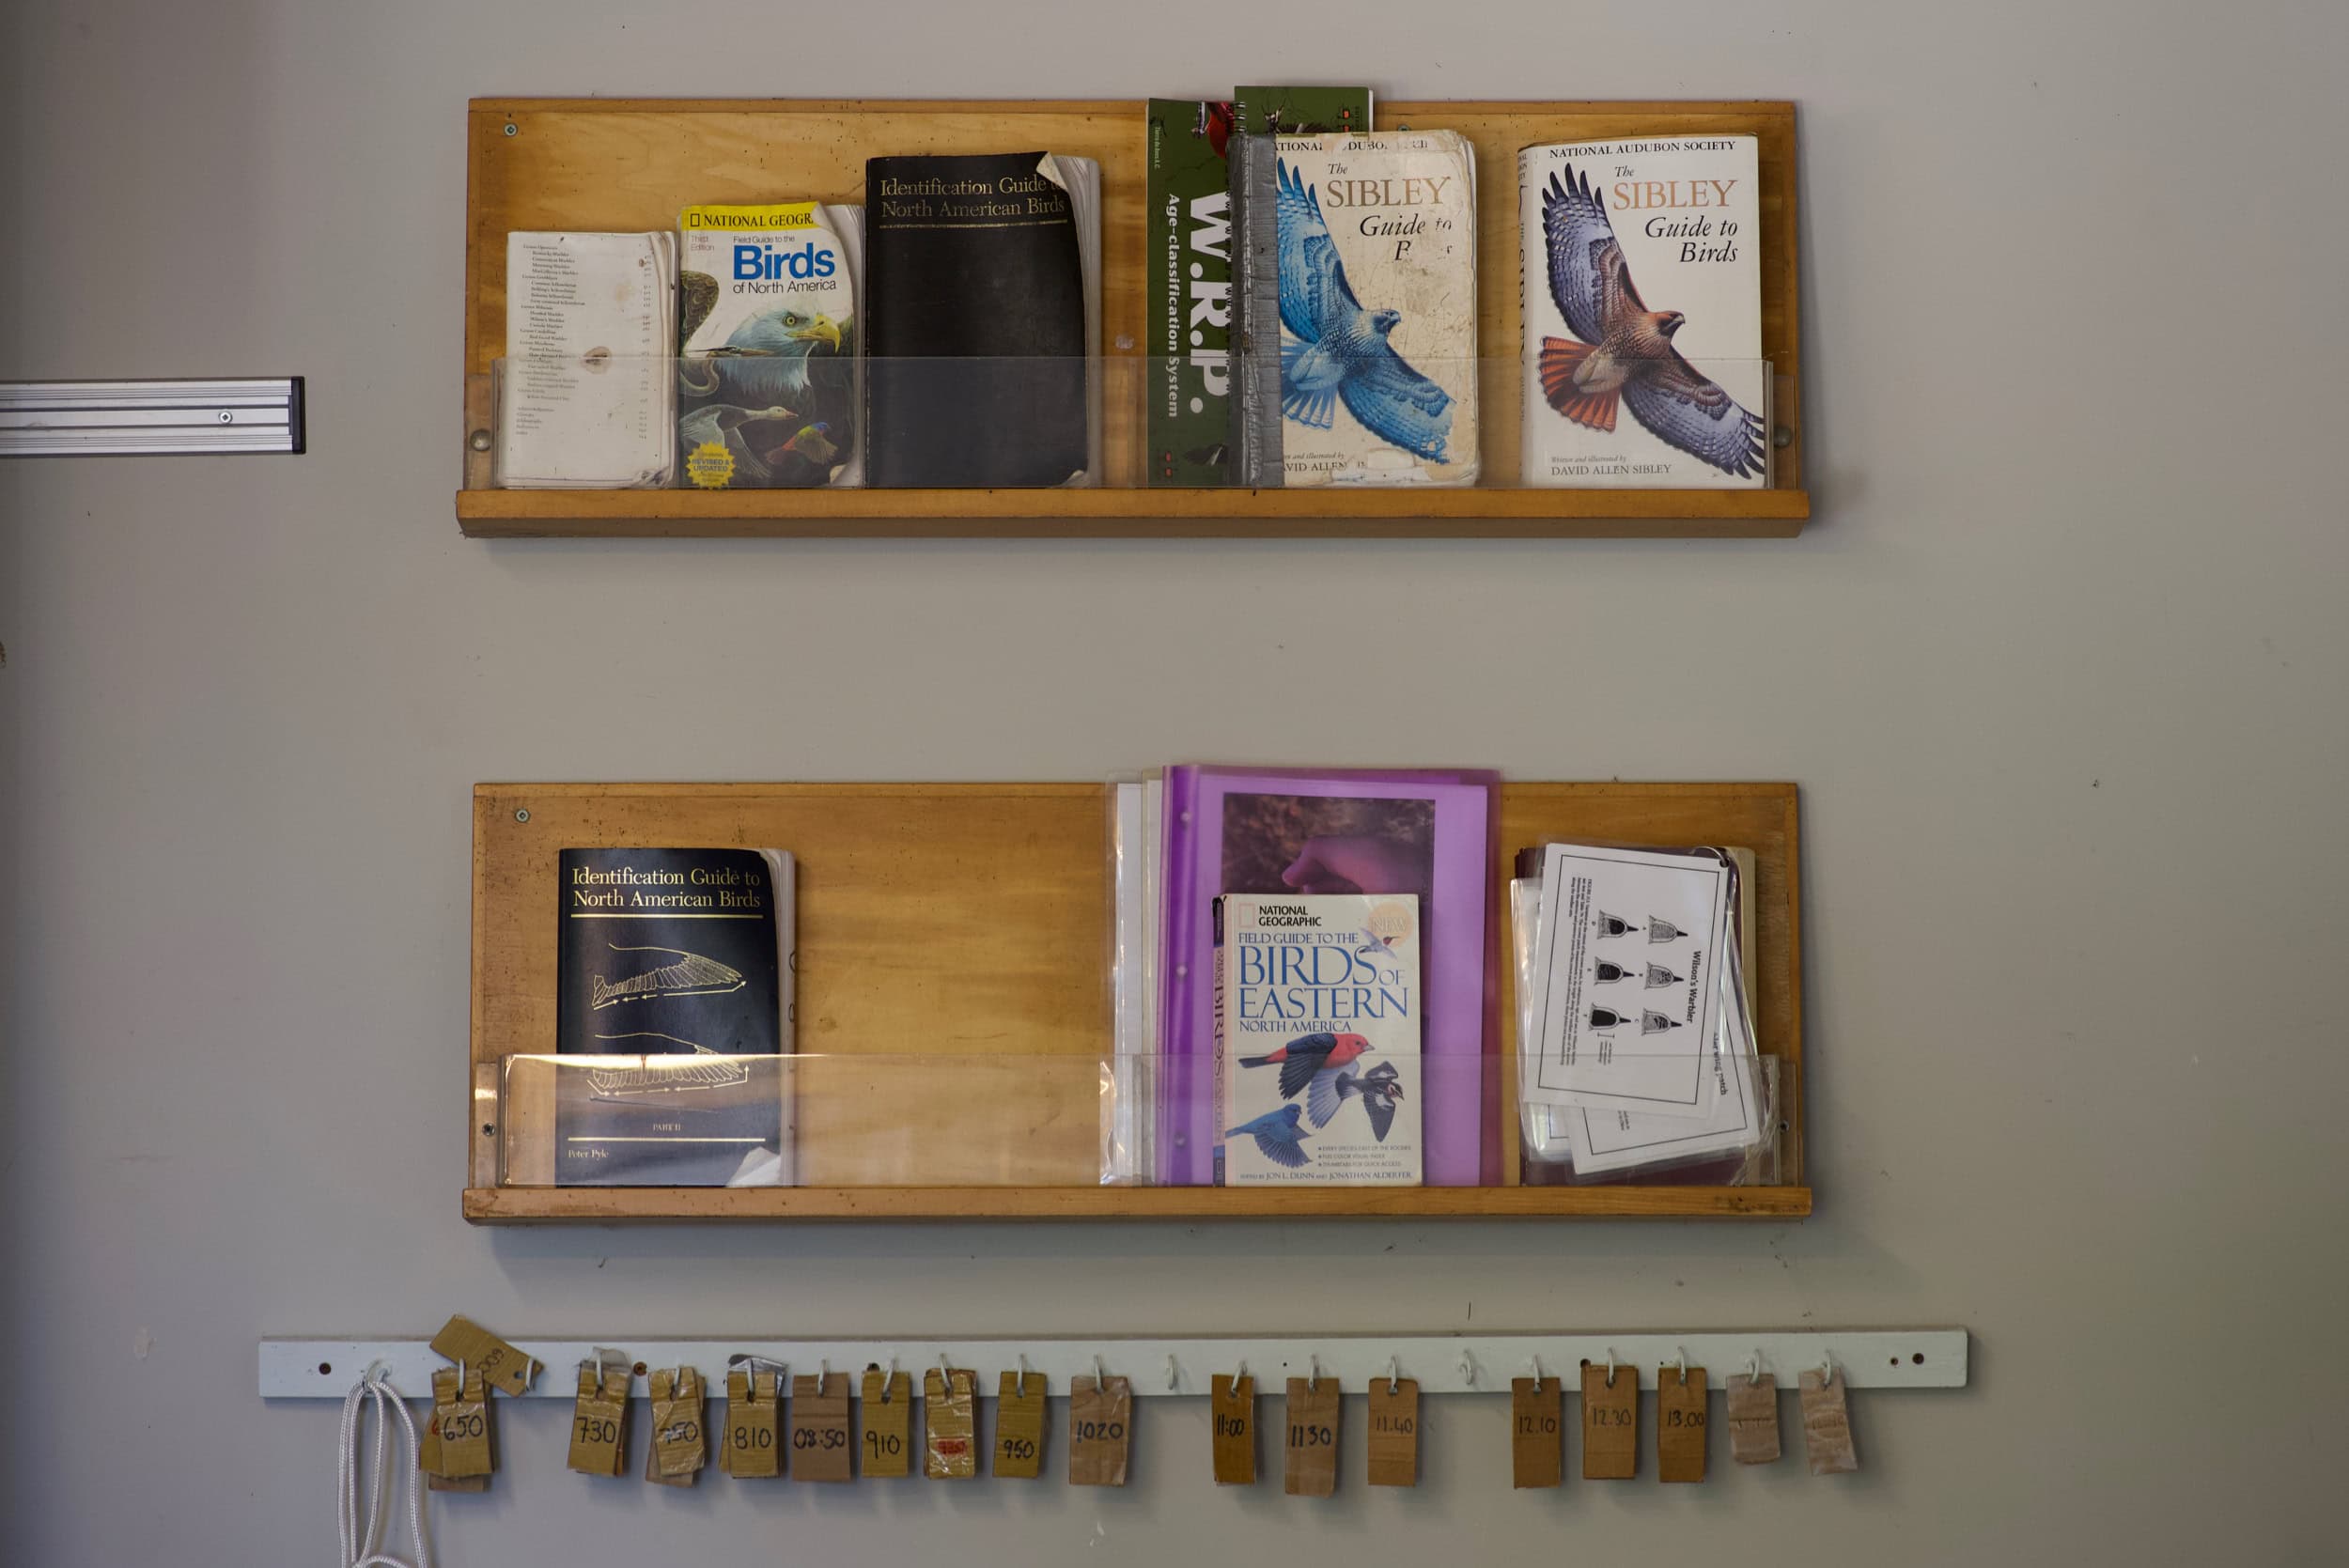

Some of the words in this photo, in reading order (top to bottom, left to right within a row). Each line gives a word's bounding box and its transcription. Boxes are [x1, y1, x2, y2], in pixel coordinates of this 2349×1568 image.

[1549, 146, 1612, 159] NATIONAL
[1616, 142, 1680, 154] AUDUBON
[1684, 141, 1735, 152] SOCIETY
[1328, 163, 1348, 176] The
[1614, 165, 1635, 179] The
[879, 177, 992, 196] Identification
[999, 175, 1047, 194] Guide
[1327, 176, 1452, 208] SIBLEY
[1613, 179, 1738, 210] SIBLEY
[881, 199, 933, 218] North
[941, 201, 1021, 218] American
[1027, 194, 1066, 215] Birds
[704, 214, 766, 227] NATIONAL
[769, 212, 814, 226] GEOGR
[1360, 212, 1426, 237] Guide
[1645, 215, 1712, 238] Guide
[1719, 218, 1738, 236] to
[733, 242, 836, 280] Birds
[1679, 241, 1738, 263] Birds
[733, 284, 745, 294] of
[748, 282, 784, 294] North
[786, 279, 836, 293] America
[1165, 353, 1180, 417] System
[1551, 465, 1590, 475] DAVID
[1593, 465, 1629, 475] ALLEN
[1632, 463, 1672, 474] SIBLEY
[572, 866, 685, 886] Identification
[691, 866, 740, 886] Guide
[744, 872, 760, 886] to
[573, 888, 625, 908] North
[630, 889, 712, 908] American
[719, 889, 761, 908] Birds
[1259, 905, 1309, 916] NATIONAL
[1258, 916, 1322, 927] GEOGRAPHIC
[1238, 932, 1272, 944] FIELD
[1273, 932, 1313, 944] GUIDE
[1316, 932, 1334, 944] TO
[1336, 932, 1360, 944] THE
[1238, 945, 1377, 986] BIRDS
[1378, 969, 1406, 986] OF
[1239, 986, 1409, 1019] EASTERN
[1239, 1020, 1286, 1033] NORTH
[1290, 1020, 1352, 1033] AMERICA
[568, 1149, 589, 1158] Peter
[1216, 1414, 1245, 1437] 11:00
[1376, 1416, 1413, 1436] 11.40
[1518, 1416, 1556, 1436] 12.10
[1592, 1407, 1631, 1427] 12.30
[1667, 1410, 1705, 1429] 13.00
[443, 1414, 484, 1442] 650
[576, 1416, 616, 1444] 730
[735, 1426, 772, 1450] 810
[1077, 1420, 1124, 1444] 1020
[793, 1427, 846, 1451] 08:50
[866, 1430, 901, 1460] 910
[1003, 1438, 1034, 1460] 950
